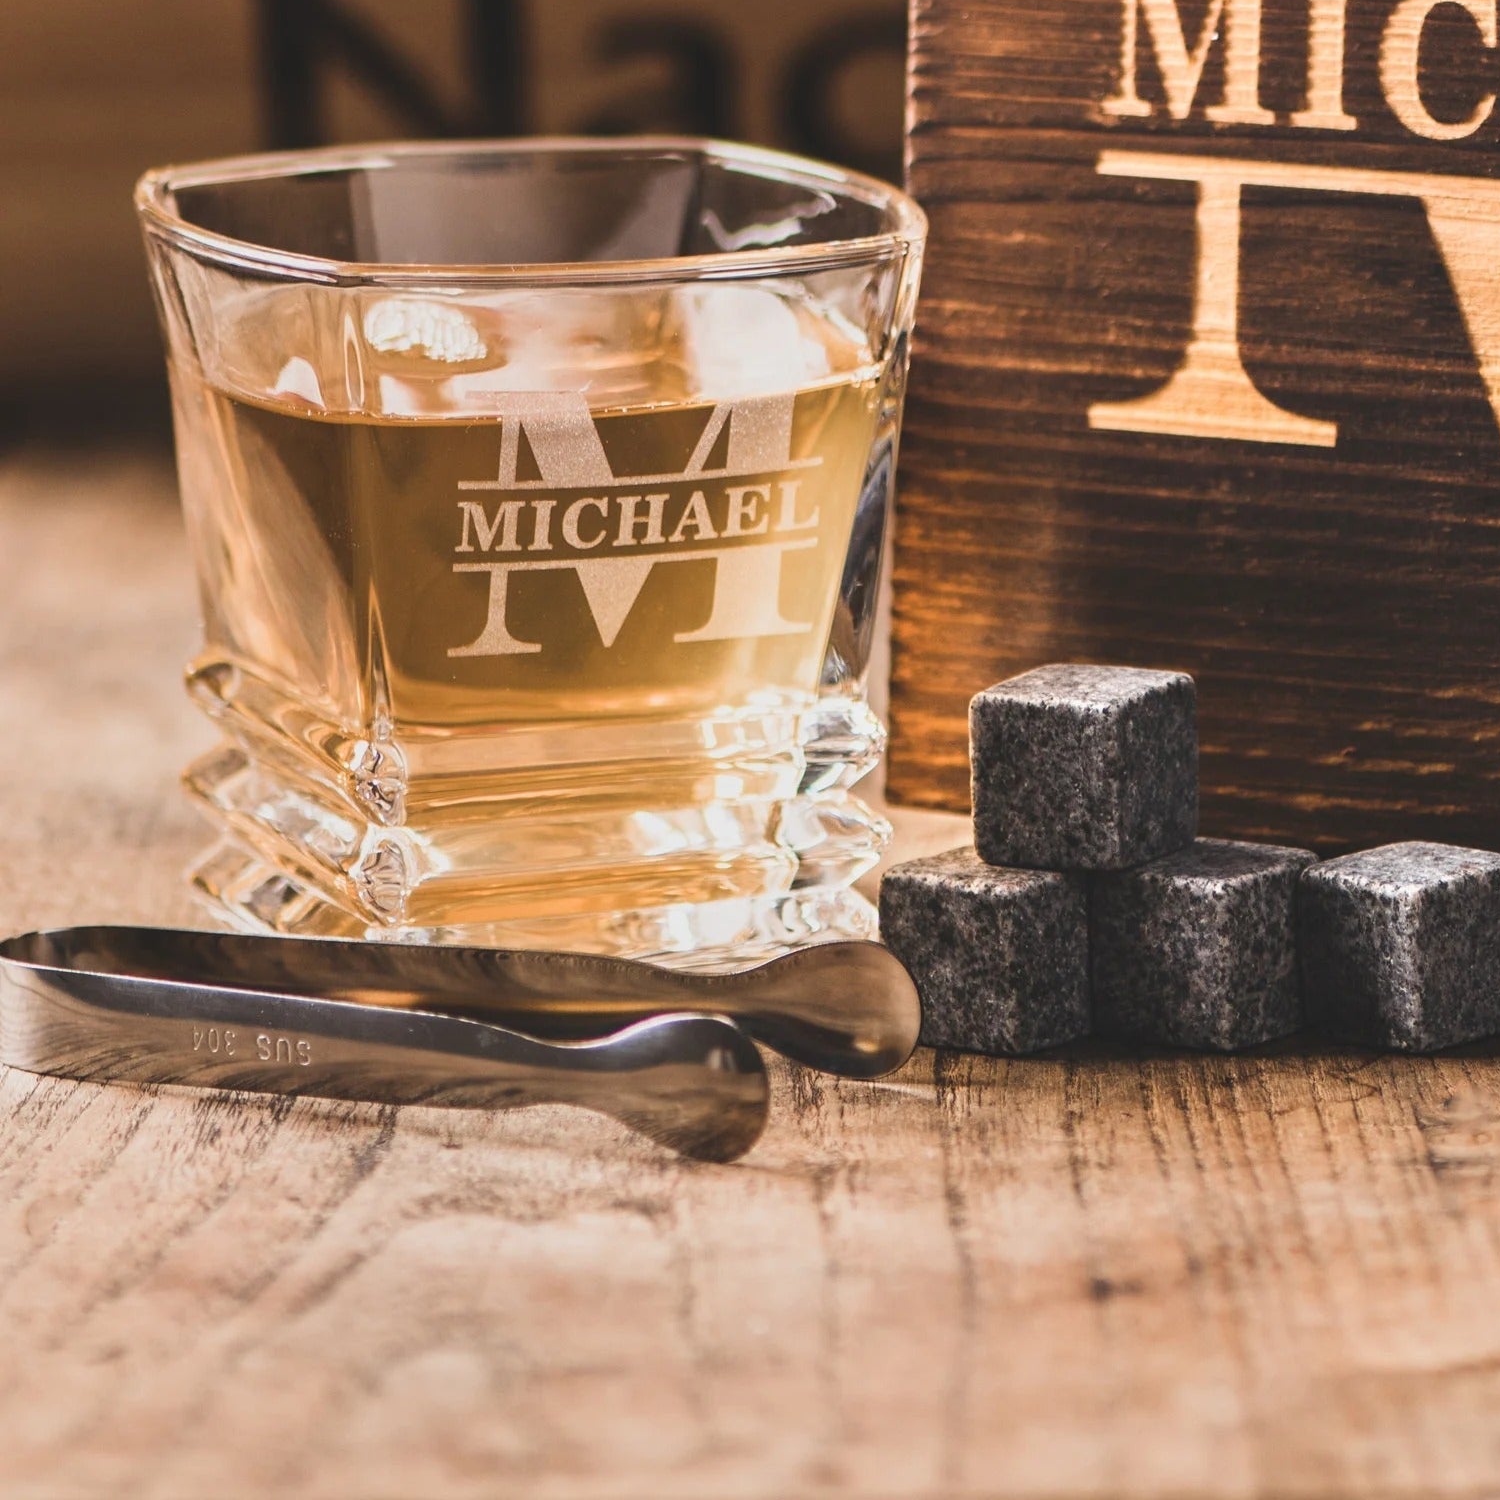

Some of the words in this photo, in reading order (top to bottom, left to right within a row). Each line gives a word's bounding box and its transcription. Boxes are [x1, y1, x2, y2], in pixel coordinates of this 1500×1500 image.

[447, 390, 824, 658] M
[454, 479, 821, 553] MICHAEL
[193, 1025, 236, 1056] 304
[256, 1033, 311, 1066] SUS
